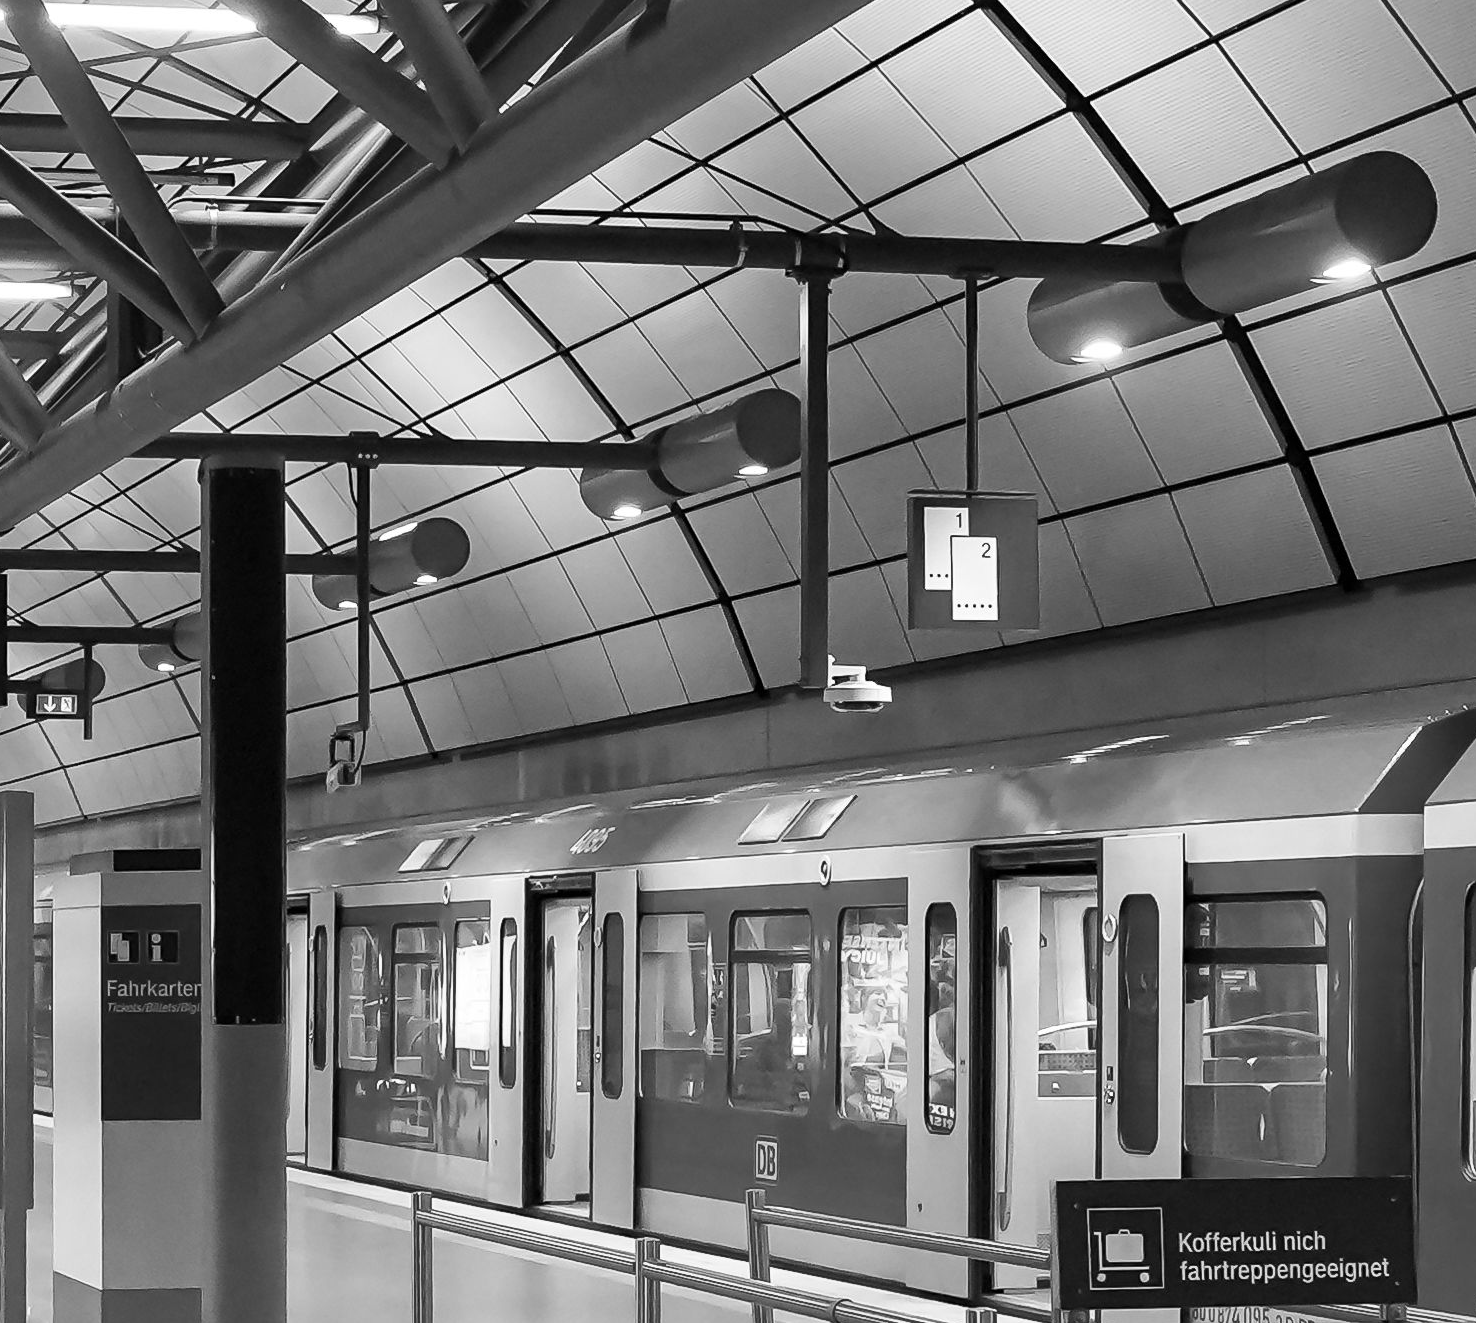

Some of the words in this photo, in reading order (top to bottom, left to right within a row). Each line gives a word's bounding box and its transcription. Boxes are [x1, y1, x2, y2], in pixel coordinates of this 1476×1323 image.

[955, 512, 962, 528] 1
[981, 542, 992, 558] 2
[757, 1143, 776, 1177] DB
[1177, 1230, 1277, 1253] Kofferkuli
[1283, 1230, 1327, 1252] nich
[1179, 1257, 1390, 1284] fahrtreppengeeignet
